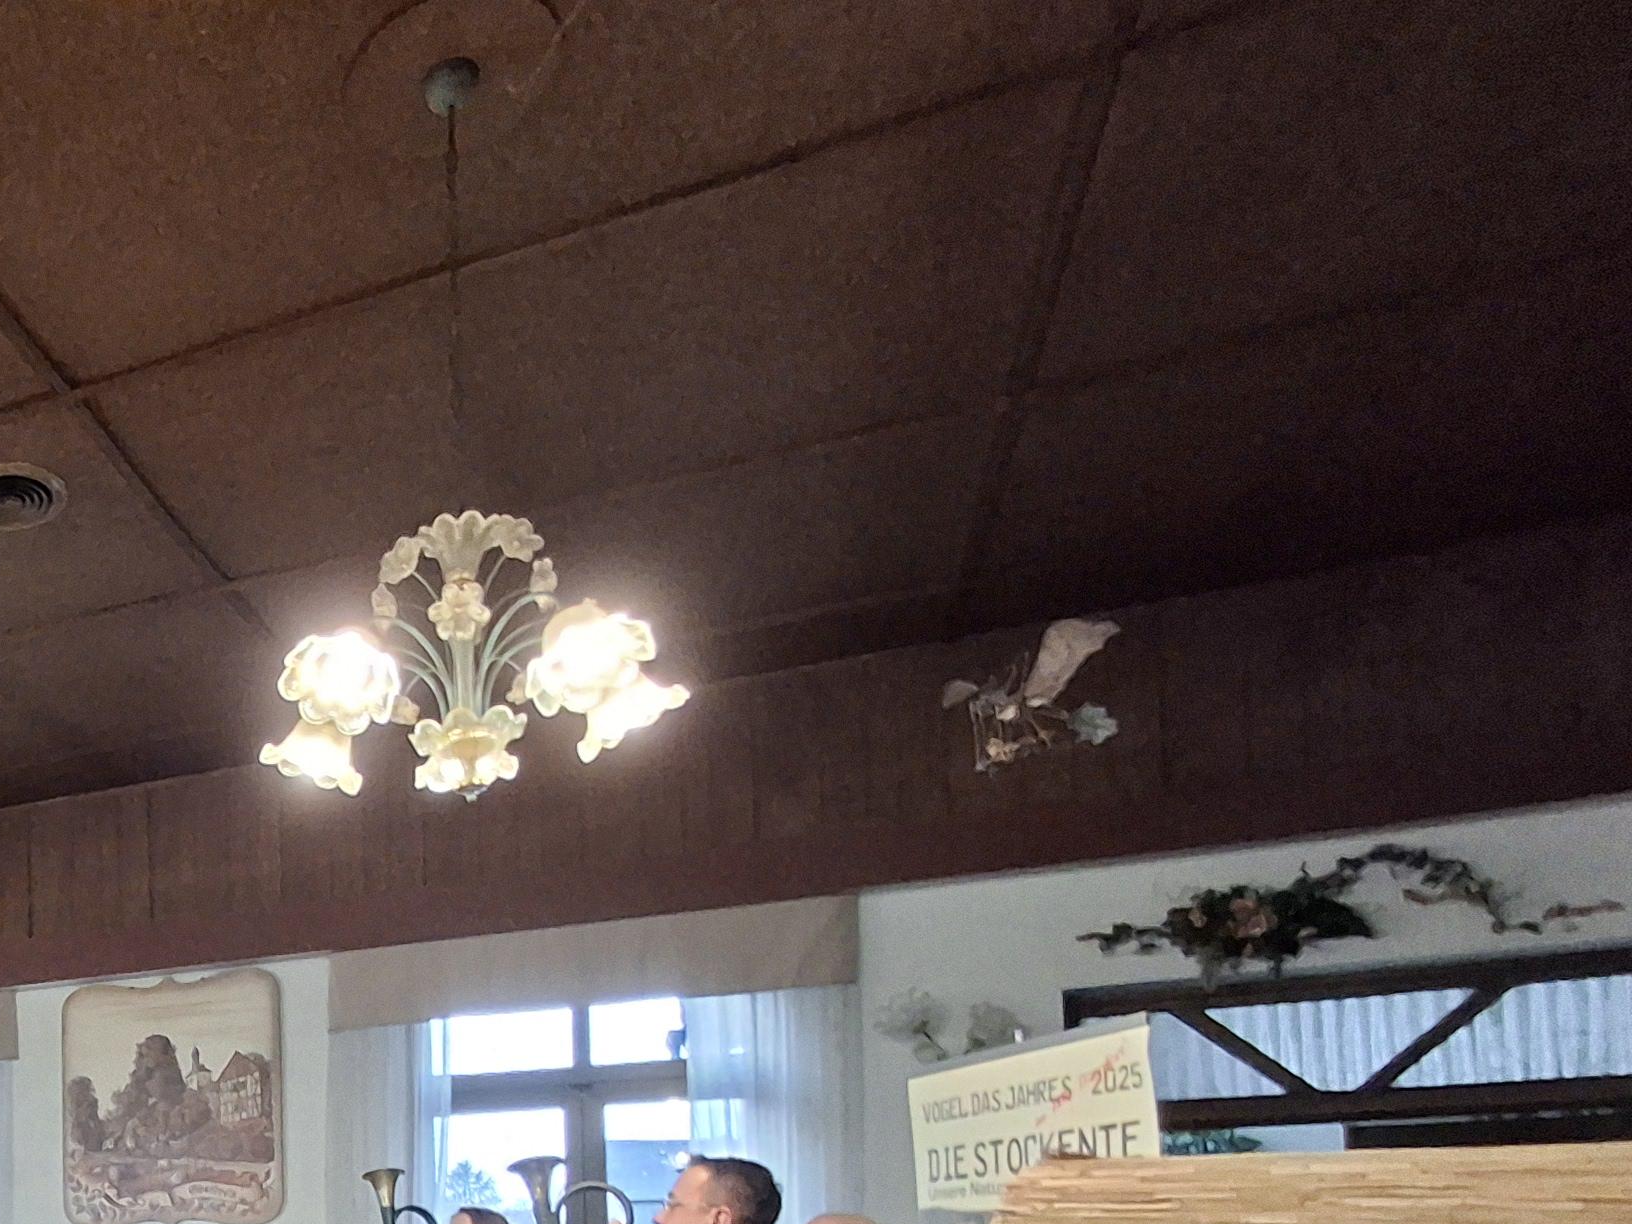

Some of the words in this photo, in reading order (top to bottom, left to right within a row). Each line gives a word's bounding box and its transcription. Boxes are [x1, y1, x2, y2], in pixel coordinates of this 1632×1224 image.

[922, 1096, 969, 1124] VOGEL
[1004, 1075, 1073, 1111] JAHRES
[1090, 1061, 1144, 1096] 2025
[927, 1145, 968, 1184] DIE
